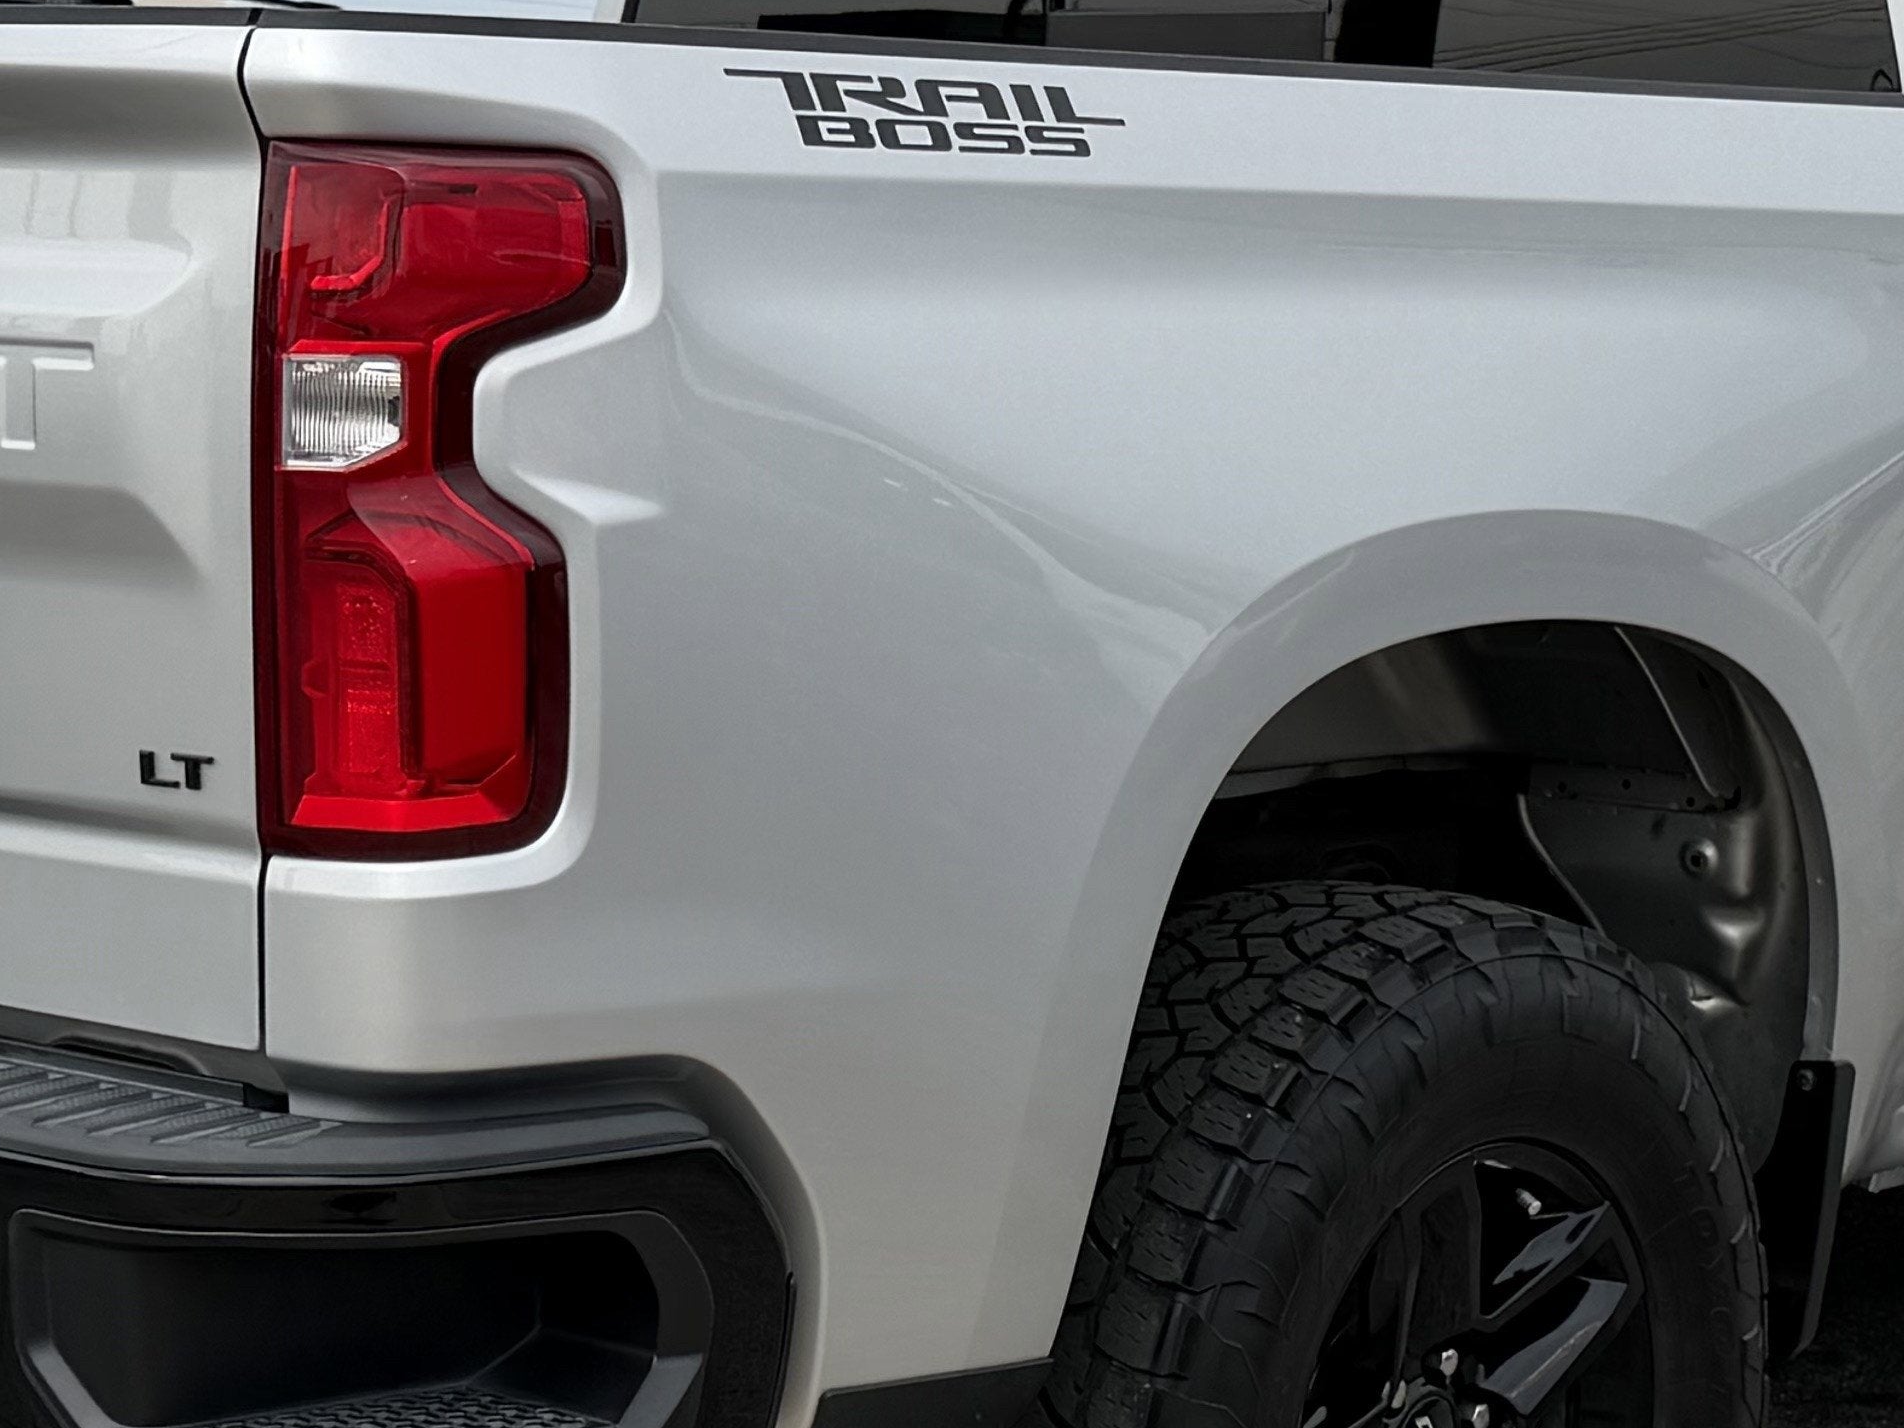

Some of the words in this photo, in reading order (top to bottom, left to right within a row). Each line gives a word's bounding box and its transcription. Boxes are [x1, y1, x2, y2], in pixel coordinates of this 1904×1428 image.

[723, 68, 1126, 126] TRAIL
[795, 115, 1091, 157] BOSS
[139, 749, 215, 790] LT
